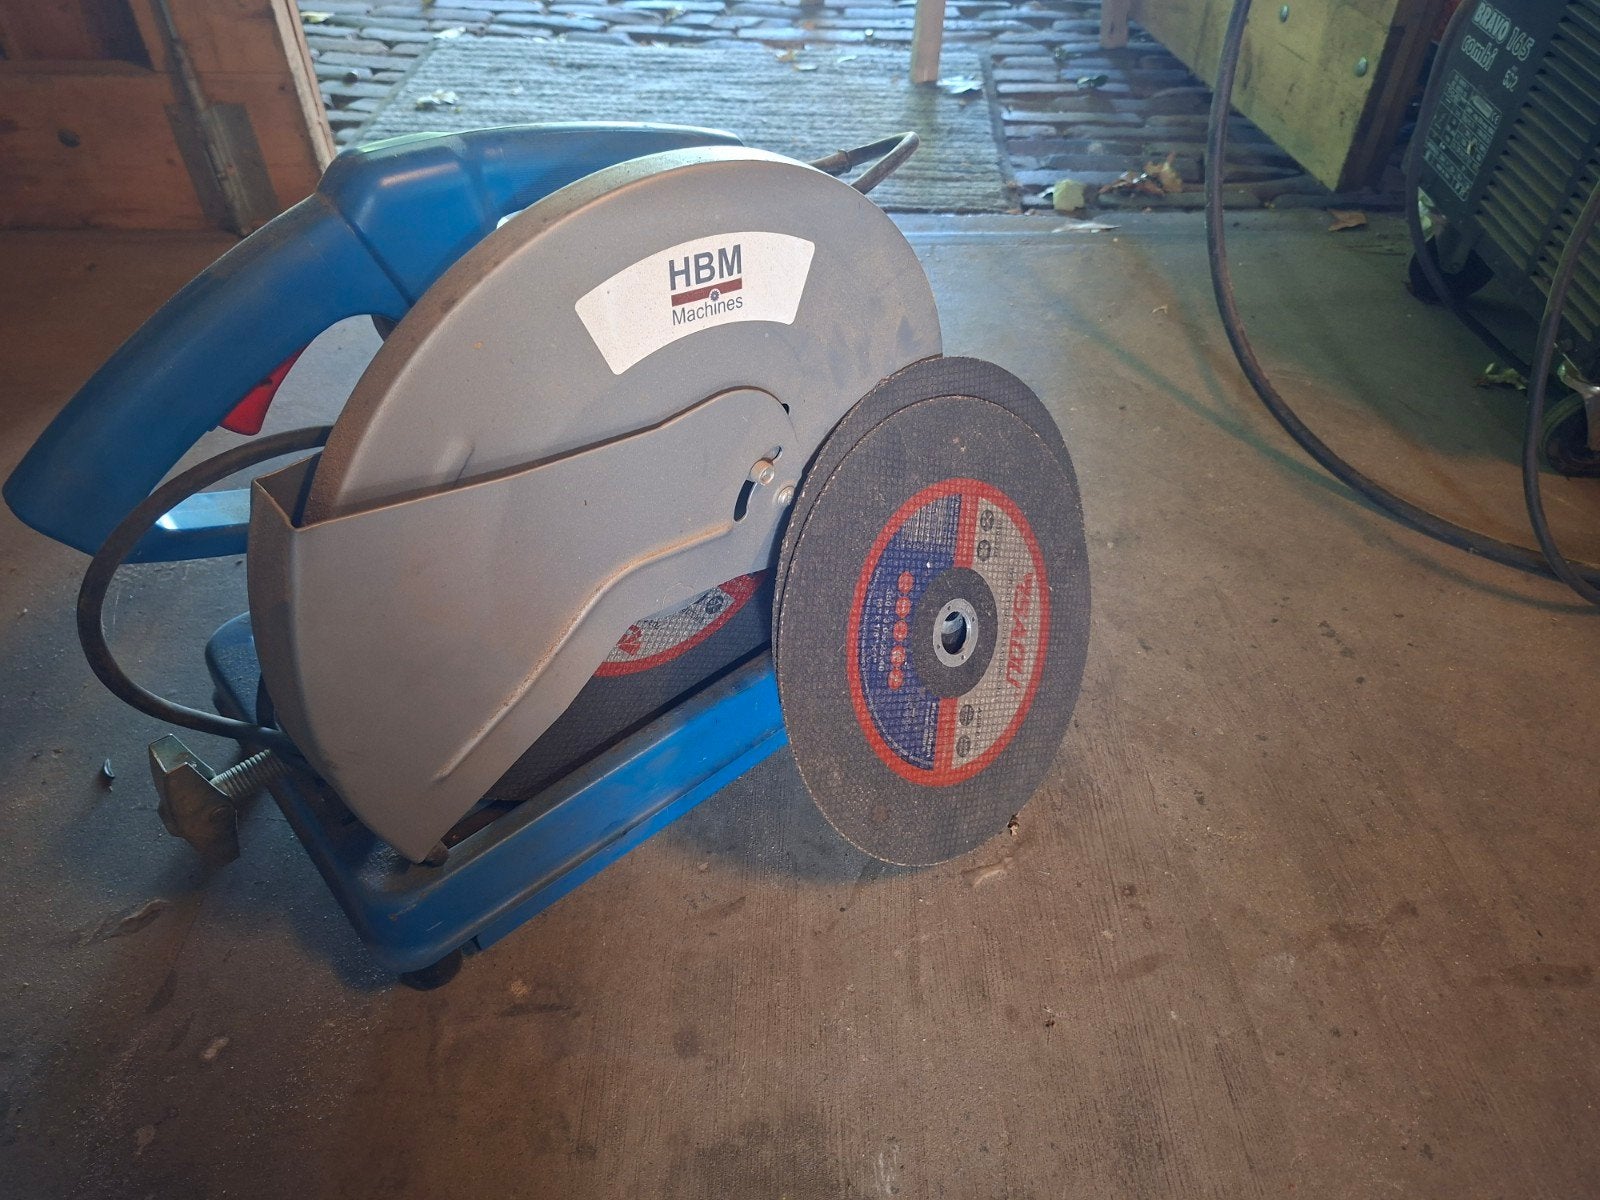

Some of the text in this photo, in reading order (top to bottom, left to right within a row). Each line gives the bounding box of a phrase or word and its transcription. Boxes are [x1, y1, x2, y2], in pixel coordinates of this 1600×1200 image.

[1473, 1, 1535, 61] BRAVO 165
[1461, 35, 1499, 72] combi
[668, 243, 742, 291] HBM
[672, 296, 743, 326] Machines
